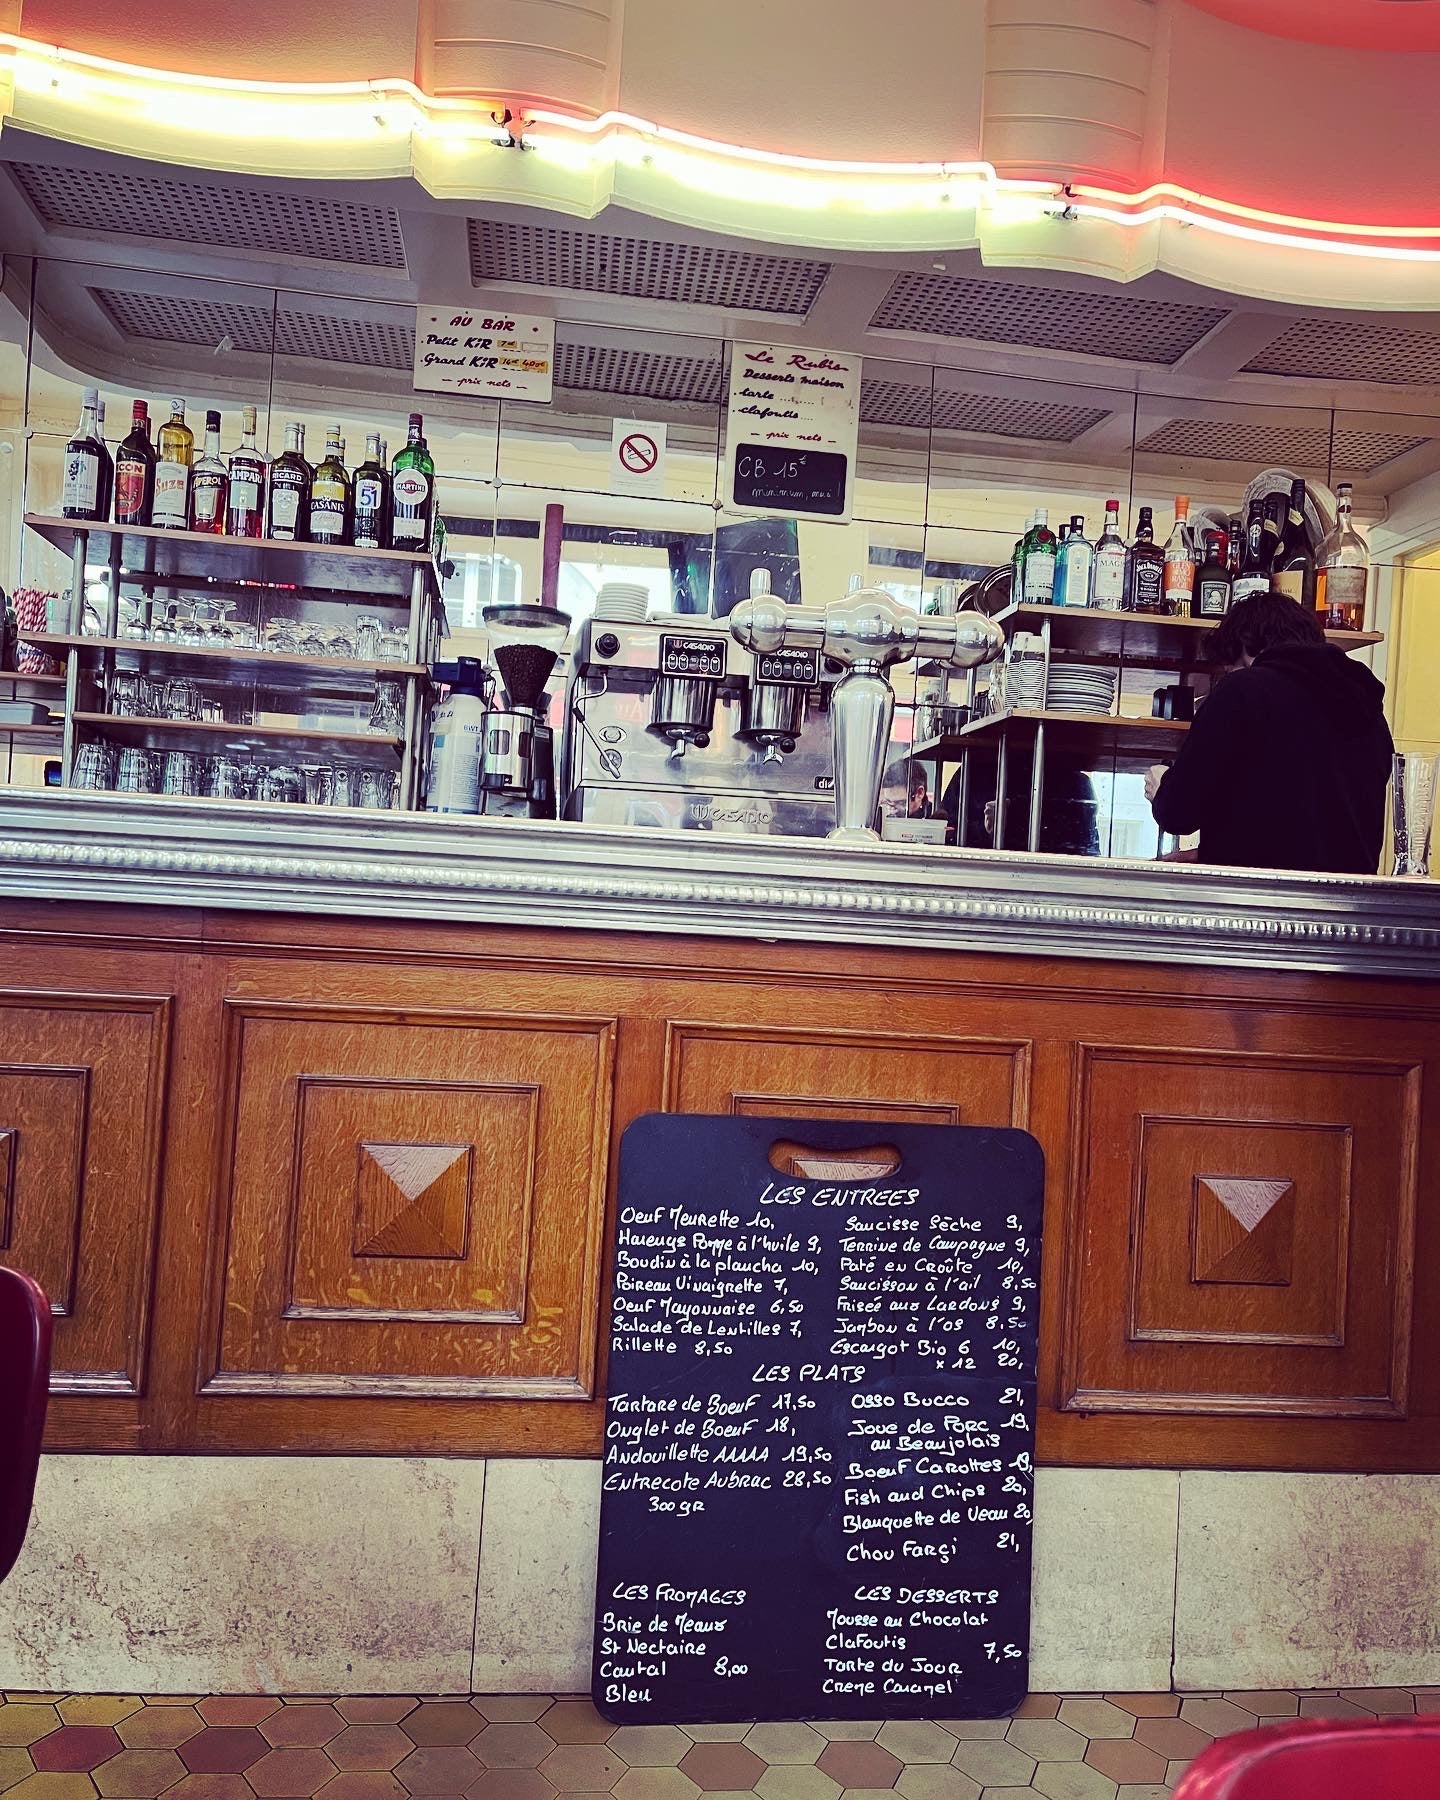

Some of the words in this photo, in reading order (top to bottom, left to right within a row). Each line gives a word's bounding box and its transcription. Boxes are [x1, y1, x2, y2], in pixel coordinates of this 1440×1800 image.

[450, 316, 473, 327] AU
[481, 318, 516, 331] BAR
[426, 334, 459, 346] Petit
[424, 353, 467, 367] Grand
[744, 350, 775, 364] Le
[786, 354, 849, 372] Rubis
[457, 377, 482, 387] prix
[486, 379, 511, 388] nets
[743, 368, 796, 383] Desserts
[739, 387, 775, 400] tarte
[738, 405, 799, 419] clafoutis
[766, 432, 789, 441] prix
[797, 433, 822, 442] nets
[738, 456, 766, 478] CB
[193, 476, 222, 489] APEROL
[272, 472, 302, 481] RICARD
[395, 483, 425, 493] MARTINI
[360, 488, 377, 507] 51
[311, 501, 344, 513] CASANIS
[683, 642, 716, 651] CASADIO
[776, 650, 809, 659] CASADIO
[759, 1183, 806, 1204] LES
[812, 1186, 920, 1206] ENTREES
[620, 1207, 665, 1223] Oeuf
[670, 1204, 739, 1230] Meurette
[845, 1215, 919, 1232] Saucisse
[751, 1233, 800, 1252] l'huile
[839, 1237, 898, 1252] Terrine
[903, 1237, 921, 1252] de
[617, 1250, 676, 1269] Boudin
[680, 1254, 691, 1269] à
[696, 1253, 711, 1269] la
[884, 1262, 907, 1272] en
[914, 1258, 973, 1274] Croûte
[616, 1272, 672, 1291] Poireau
[676, 1276, 763, 1298] Vinaigrette
[839, 1275, 918, 1291] Saucisson
[925, 1277, 938, 1291] à
[944, 1274, 981, 1291] l'ail
[613, 1296, 656, 1313] Oeuf
[770, 1299, 804, 1314] 6,50
[612, 1316, 673, 1333] Salade
[680, 1320, 703, 1335] de
[707, 1319, 781, 1336] Lentilles
[906, 1317, 919, 1333] à
[928, 1316, 964, 1332] l'os
[612, 1336, 677, 1354] Rillette
[694, 1341, 733, 1356] 8,50
[830, 1338, 909, 1359] Escargot
[918, 1340, 946, 1356] Bio
[958, 1340, 970, 1354] 6
[952, 1357, 977, 1370] 12
[752, 1364, 790, 1382] LES
[799, 1364, 865, 1383] PLATS
[608, 1394, 677, 1413] Tartare
[682, 1394, 702, 1412] de
[772, 1392, 816, 1411] 17,50
[851, 1394, 895, 1409] Osso
[904, 1392, 969, 1407] Bucco
[674, 1418, 695, 1435] de
[847, 1420, 898, 1436] Joue
[907, 1419, 935, 1434] de
[944, 1415, 990, 1432] Porc
[606, 1442, 709, 1464] Andouillette
[782, 1446, 833, 1463] 19,50
[871, 1439, 891, 1451] au
[896, 1433, 1001, 1456] Beaujolais
[916, 1457, 1002, 1474] Carottes
[603, 1472, 700, 1491] Entrecote
[783, 1470, 832, 1488] 28,50
[845, 1488, 881, 1506] Fish
[888, 1486, 924, 1502] and
[931, 1483, 985, 1501] Chips
[649, 1497, 676, 1512] 300
[939, 1510, 961, 1524] de
[968, 1505, 1008, 1521] Veau
[846, 1543, 894, 1562] Chou
[613, 1581, 649, 1600] LES
[655, 1583, 747, 1608] FROMAGES
[854, 1586, 891, 1601] LES
[897, 1587, 999, 1604] DESSERTS
[603, 1612, 642, 1633] Brie
[648, 1614, 668, 1632] de
[827, 1608, 878, 1629] Mousse
[884, 1616, 902, 1627] au
[909, 1611, 989, 1627] Chocolat
[600, 1637, 621, 1655] St
[627, 1638, 706, 1655] Nectaire
[826, 1632, 906, 1650] Clafoutis
[983, 1642, 1022, 1663] 7,50
[714, 1656, 748, 1677] 8,00
[824, 1658, 875, 1672] Tarte
[882, 1658, 904, 1672] du
[911, 1657, 963, 1674] Jour
[605, 1683, 652, 1702] Bleu
